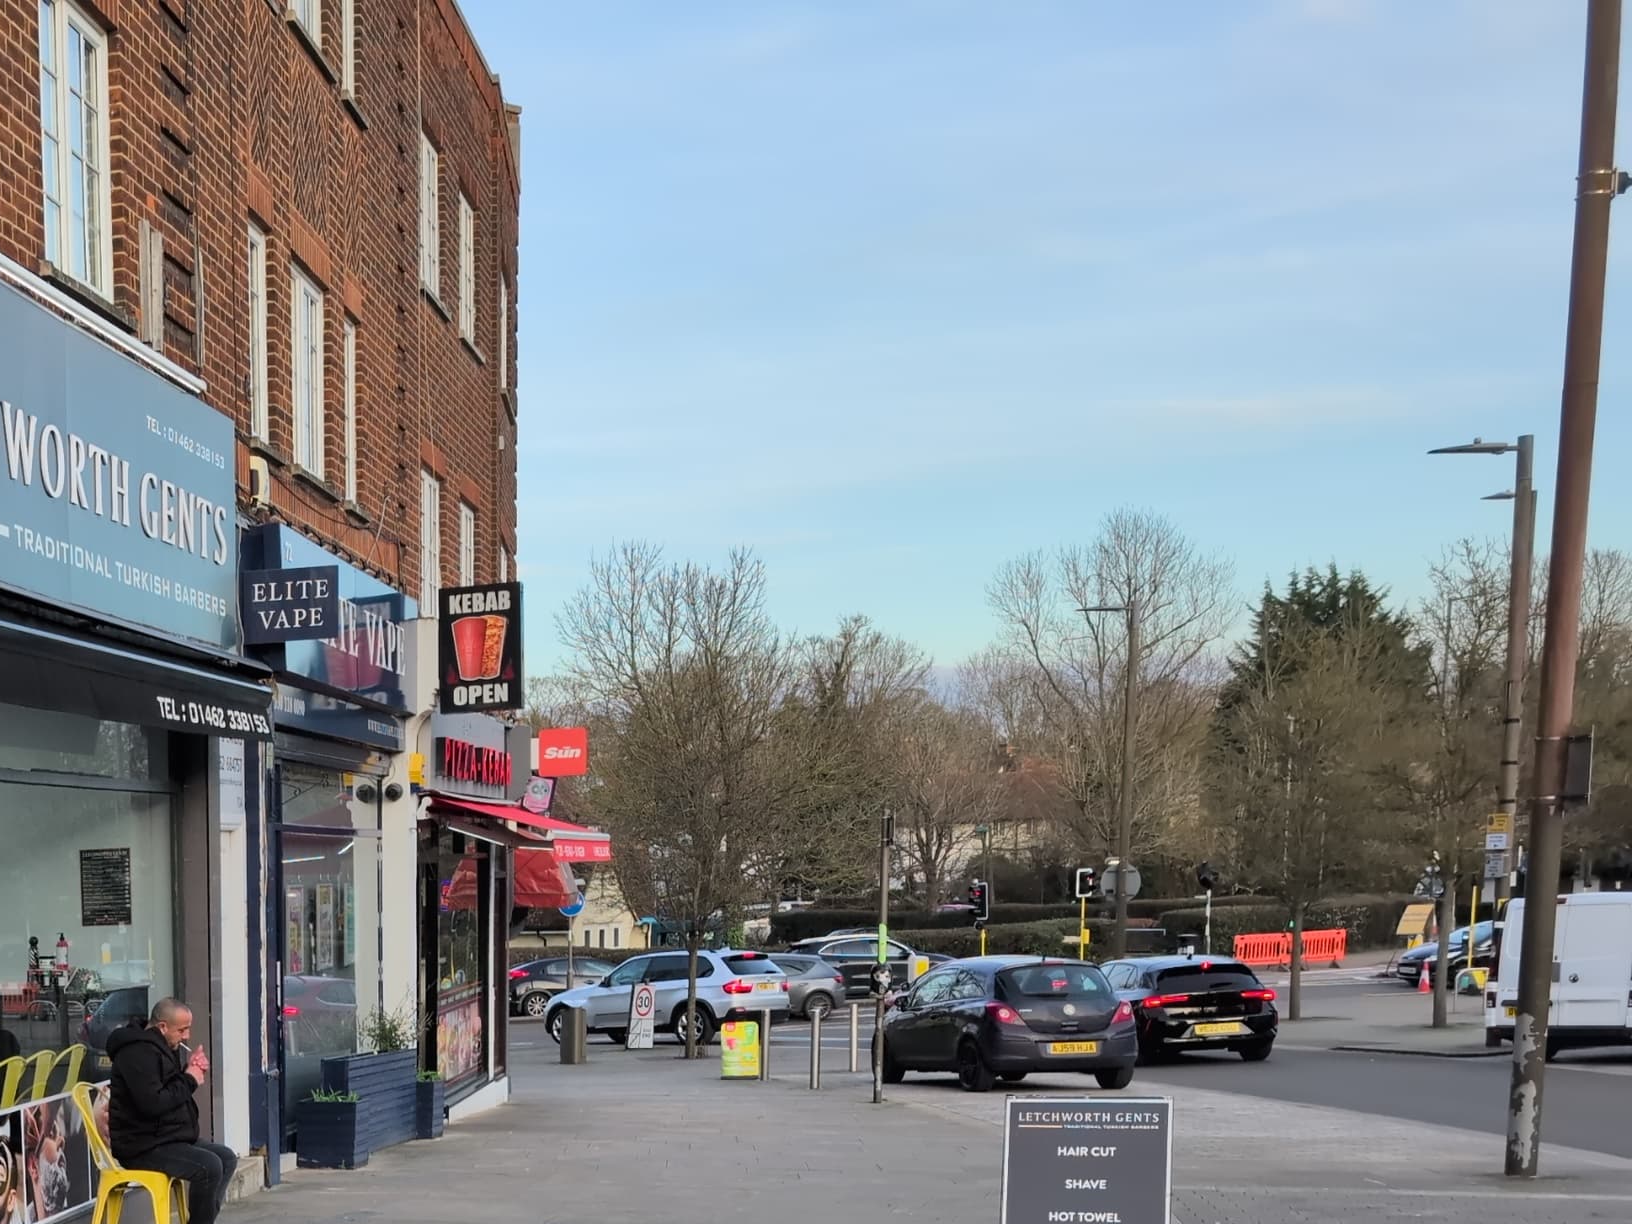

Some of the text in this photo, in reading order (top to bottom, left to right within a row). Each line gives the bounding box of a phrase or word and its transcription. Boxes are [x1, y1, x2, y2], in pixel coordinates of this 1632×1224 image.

[168, 427, 194, 451] 01462
[195, 444, 225, 470] 338153
[140, 472, 227, 566] GENTS
[14, 524, 227, 617] TRADITIONAL TURKISH BARBERS
[252, 579, 329, 602] ELITE
[449, 590, 511, 615] KEBAB
[258, 608, 324, 630] VAPE
[363, 609, 406, 677] VAPE
[453, 682, 509, 706] OPEN
[189, 702, 226, 729] 01462
[227, 710, 269, 734] 338153
[544, 746, 582, 760] Sun
[638, 996, 650, 1008] 30
[1019, 1112, 1160, 1123] LETCHWORTH GENTS
[1057, 1146, 1117, 1157] HAIR CUT
[1065, 1179, 1107, 1190] SHAVE
[1048, 1211, 1121, 1223] HOT TOWEL
